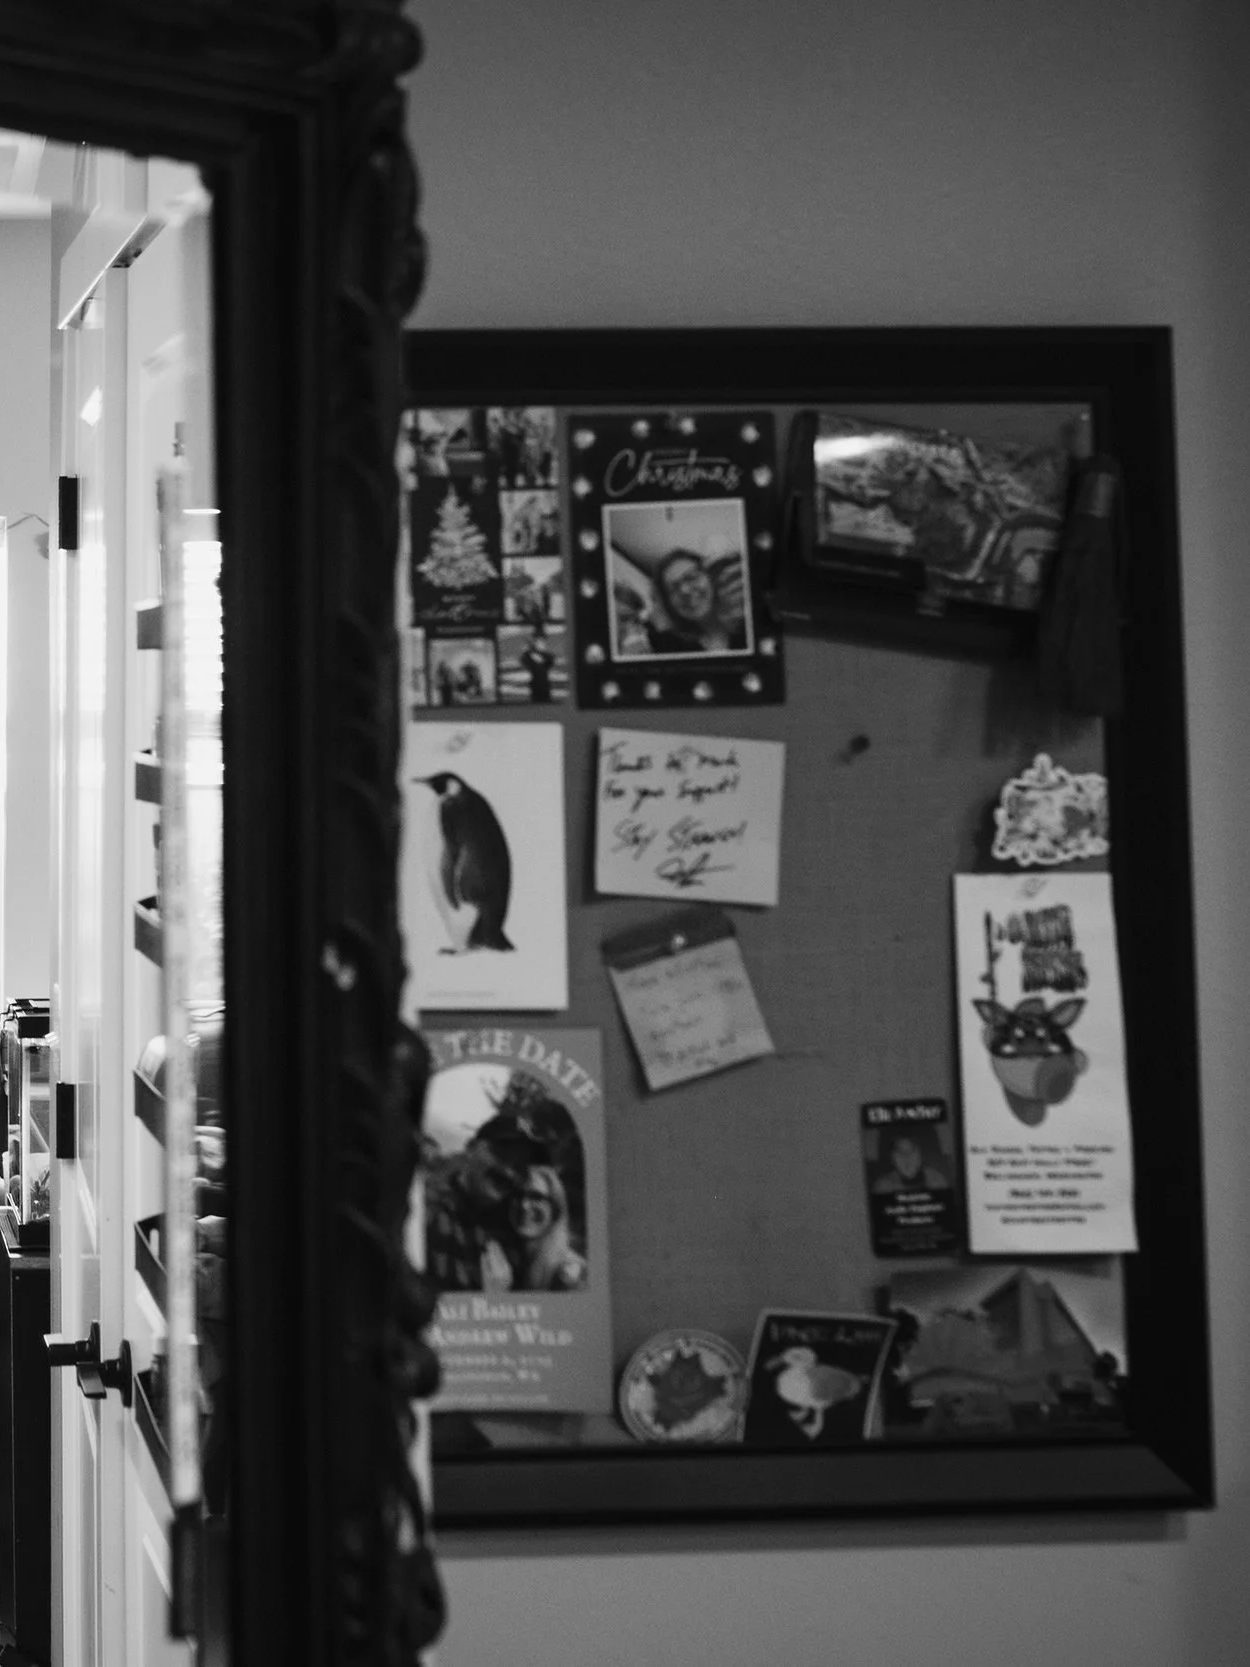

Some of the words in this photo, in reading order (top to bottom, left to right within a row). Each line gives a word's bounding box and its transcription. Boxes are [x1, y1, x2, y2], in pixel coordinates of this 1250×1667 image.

[604, 448, 743, 497] Christmas
[443, 1030, 514, 1060] THE
[517, 1034, 601, 1108] DATE
